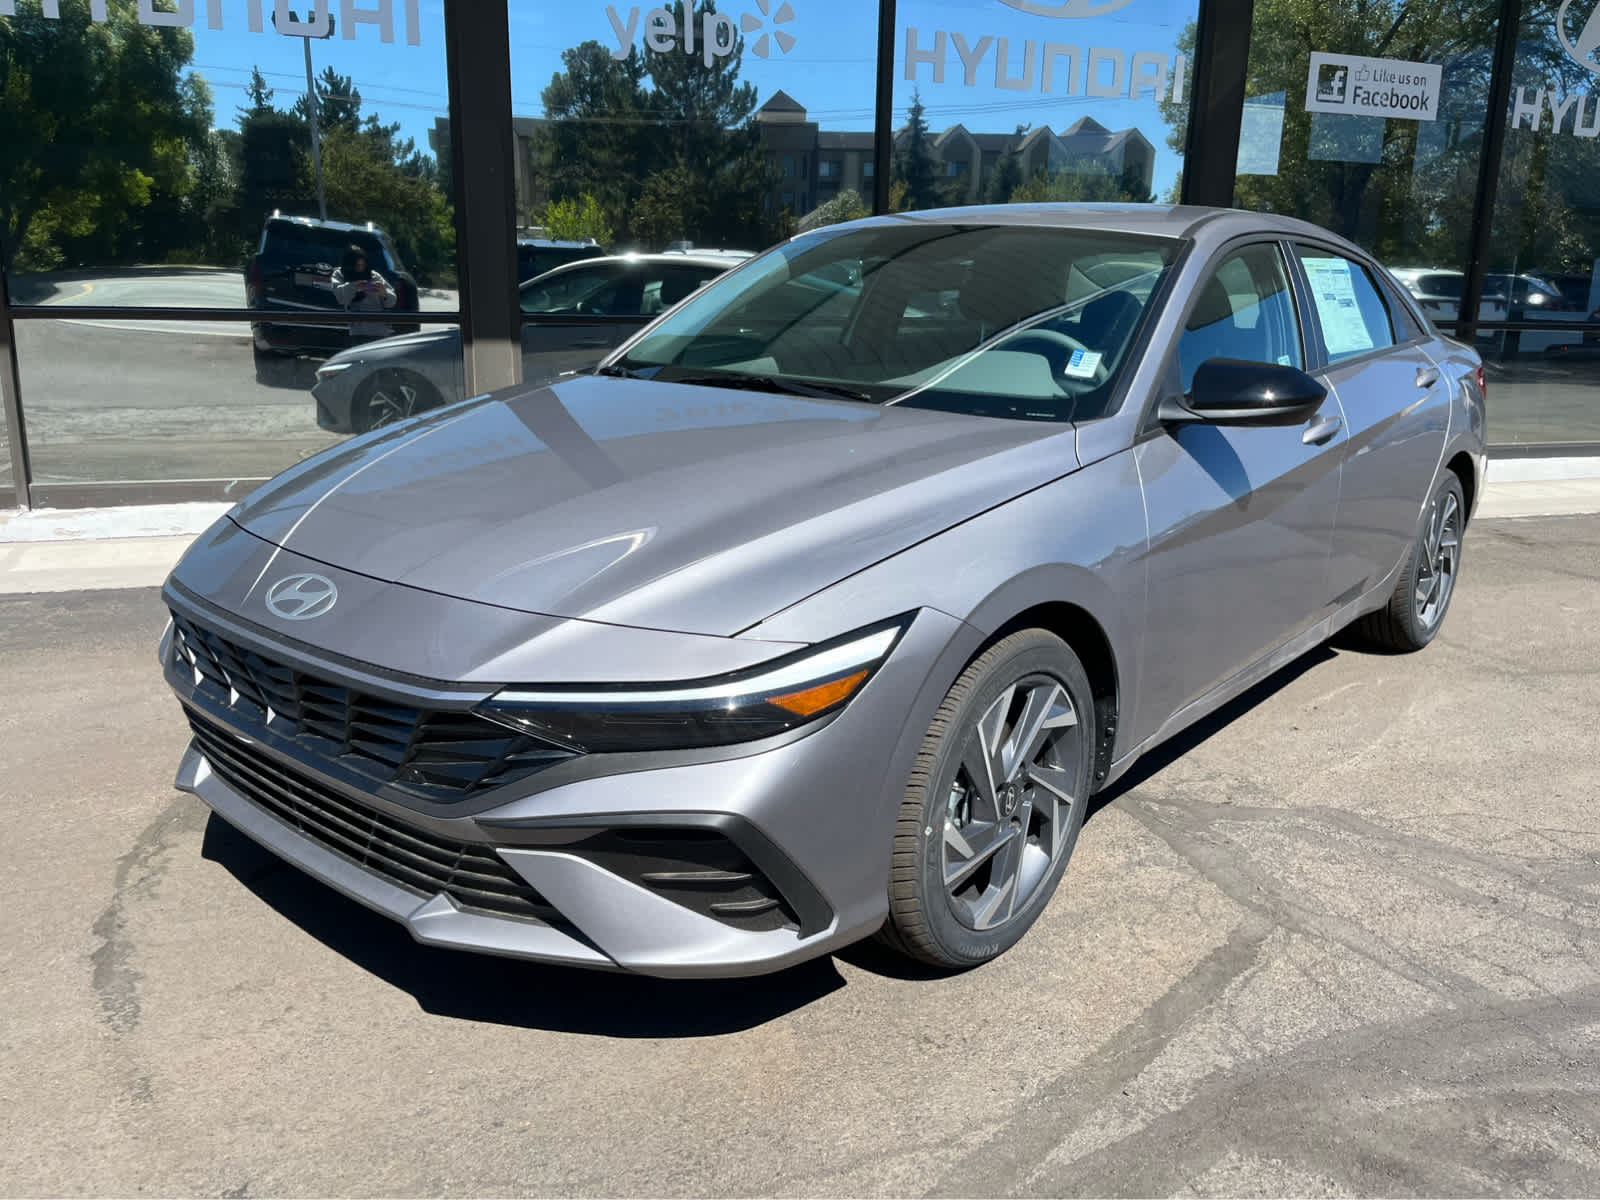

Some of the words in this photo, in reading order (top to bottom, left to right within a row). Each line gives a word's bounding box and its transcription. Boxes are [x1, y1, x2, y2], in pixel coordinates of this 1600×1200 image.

[605, 0, 736, 69] yelp
[904, 27, 1186, 104] HYUNDAI
[1373, 69, 1396, 84] Like
[1398, 75, 1411, 85] us
[1413, 76, 1427, 87] on
[1353, 86, 1430, 111] Facebook
